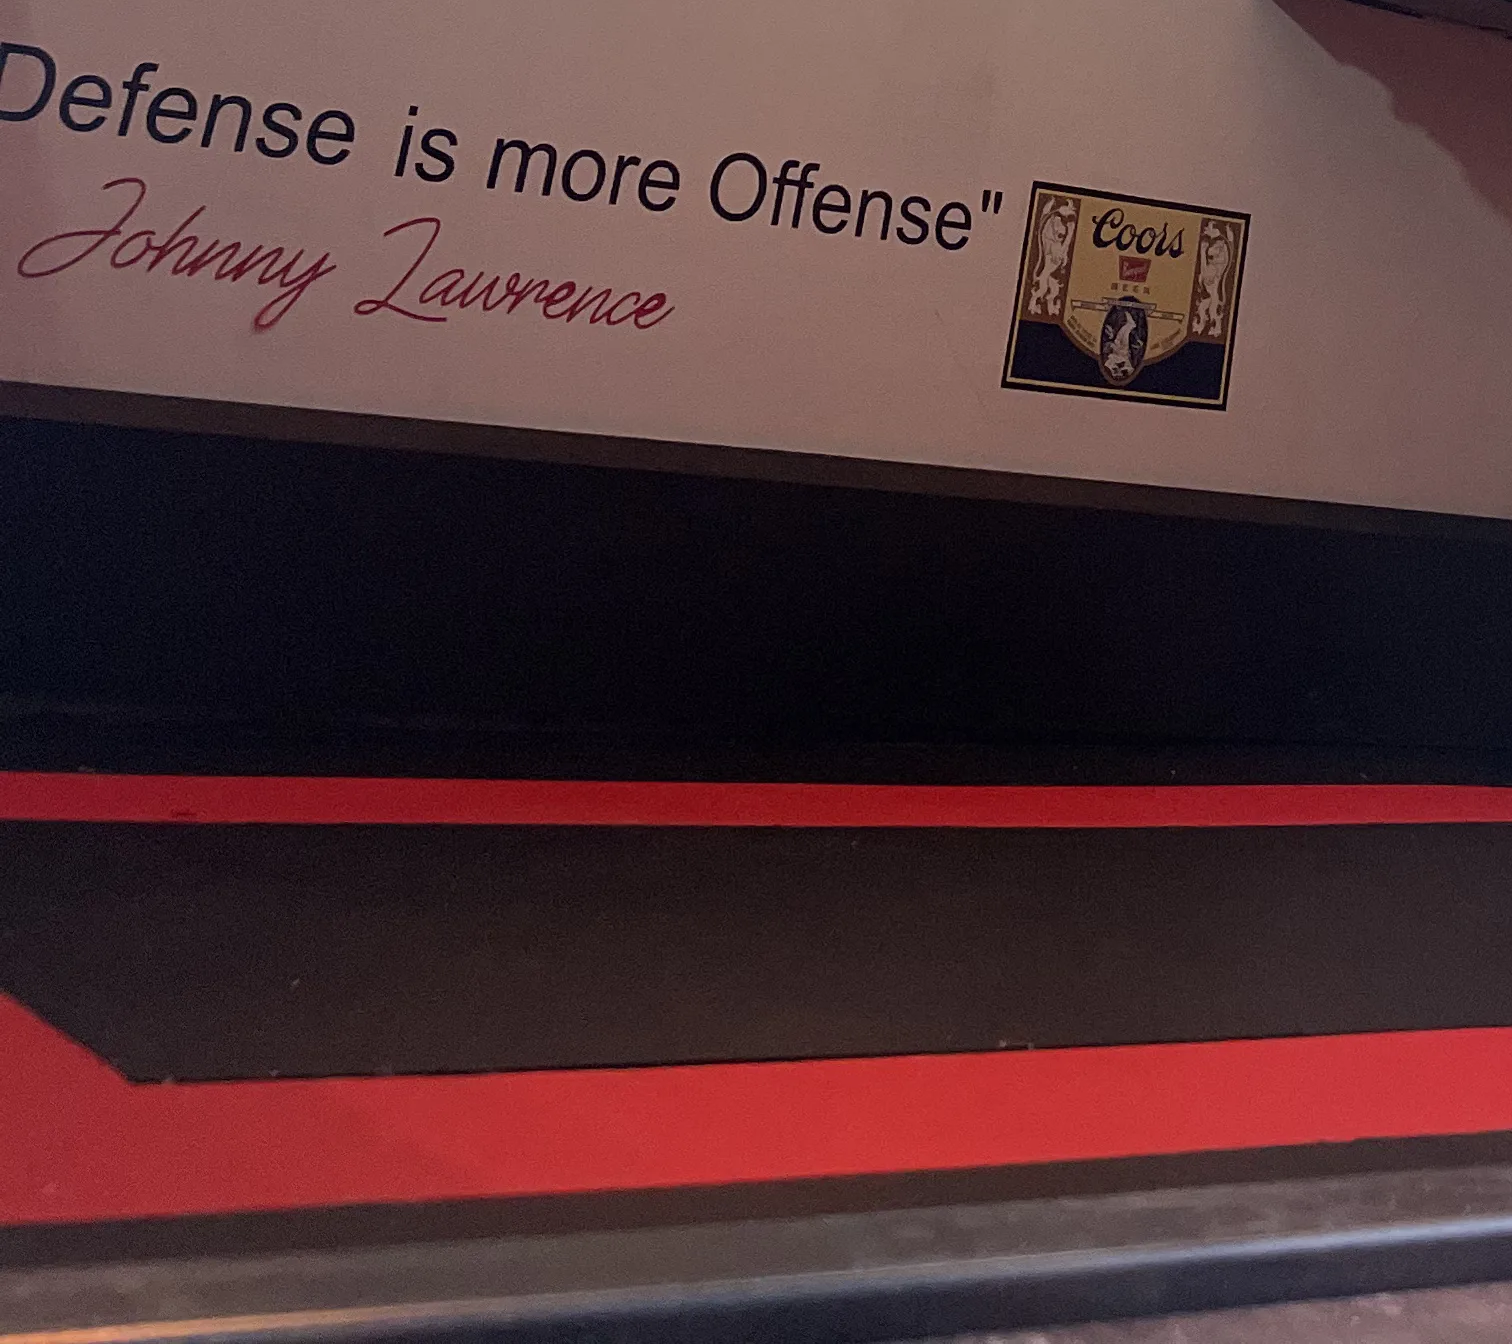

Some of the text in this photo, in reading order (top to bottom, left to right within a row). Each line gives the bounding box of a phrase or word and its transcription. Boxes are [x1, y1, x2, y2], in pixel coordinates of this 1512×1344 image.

[0, 41, 1004, 252] Defense is more Offense"
[17, 178, 675, 334] Johnny Lawrence
[1091, 208, 1185, 259] Coors
